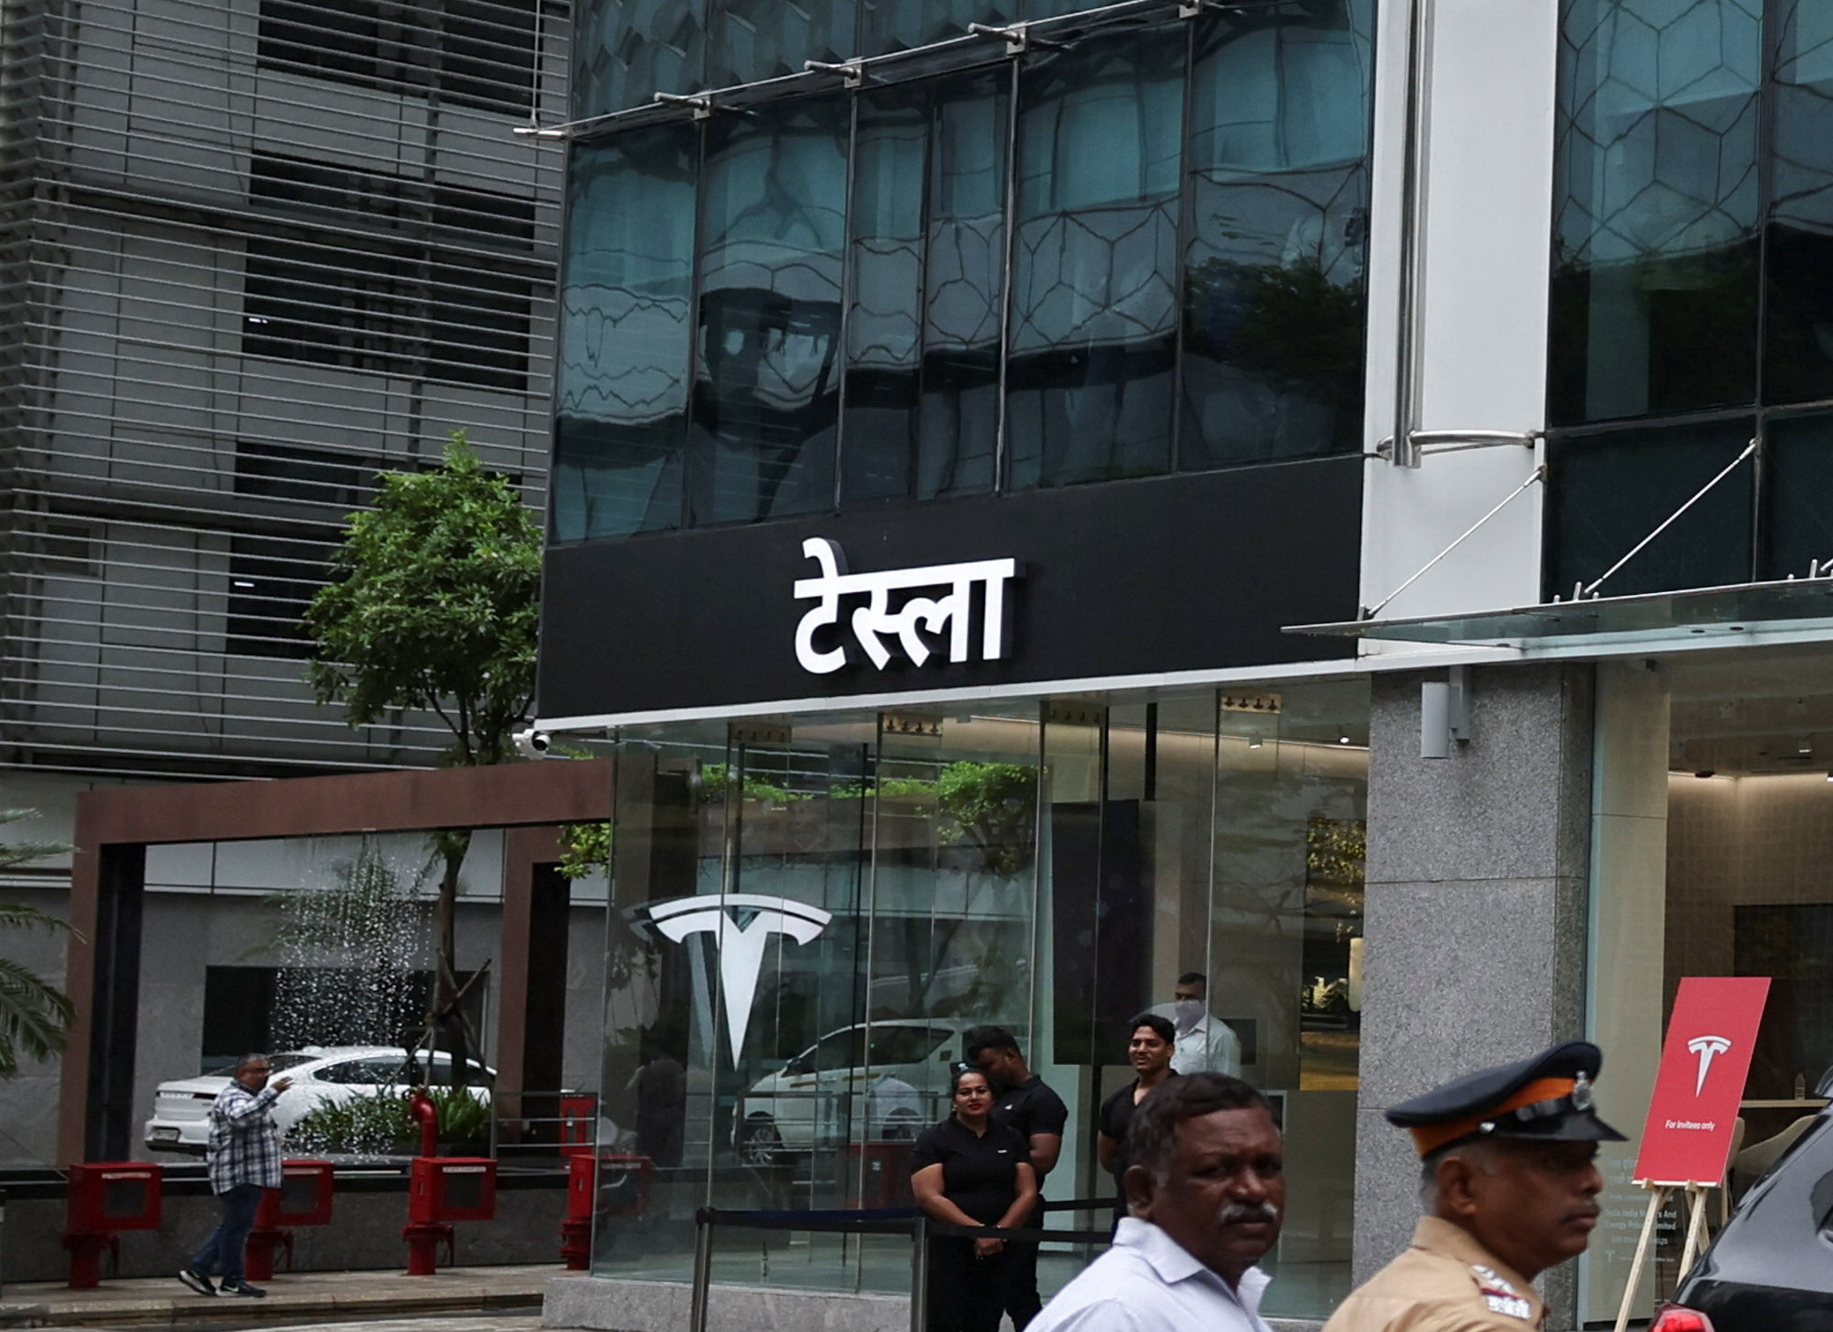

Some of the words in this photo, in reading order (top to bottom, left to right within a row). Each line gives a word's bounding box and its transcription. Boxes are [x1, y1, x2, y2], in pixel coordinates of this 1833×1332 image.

[794, 537, 1014, 674] टेस्ला
[1665, 1119, 1676, 1129] For
[1701, 1121, 1715, 1131] only
